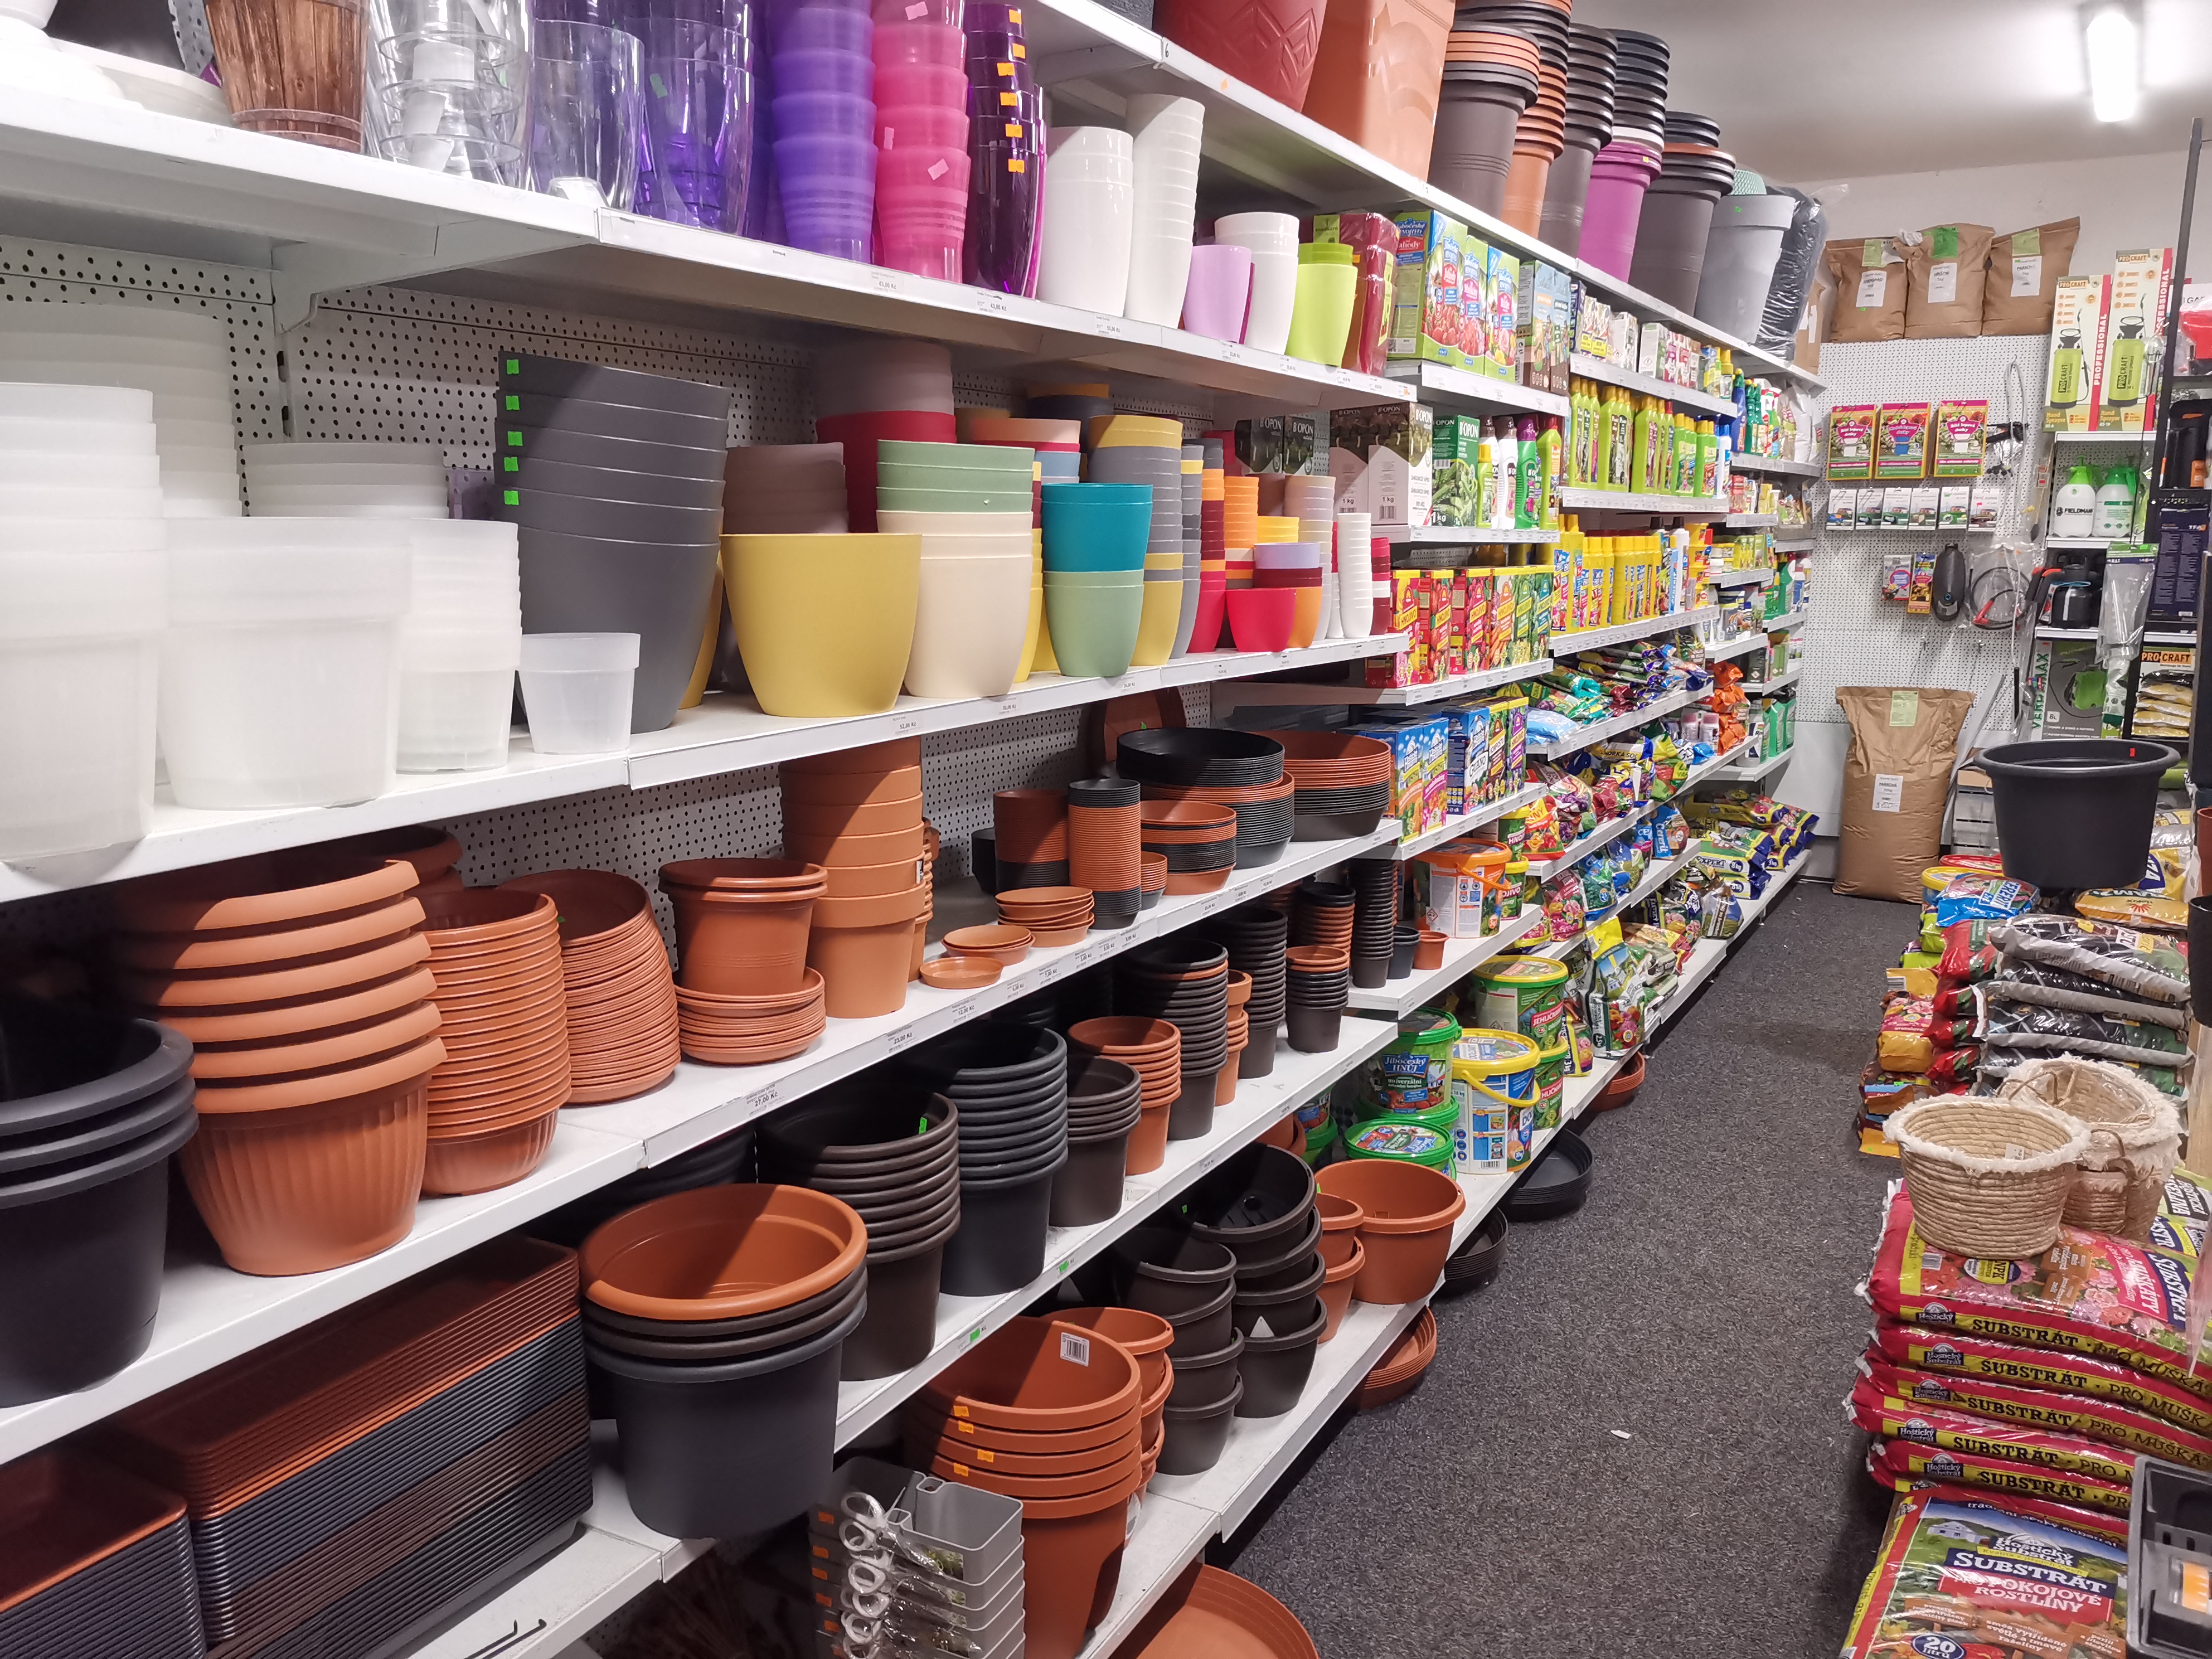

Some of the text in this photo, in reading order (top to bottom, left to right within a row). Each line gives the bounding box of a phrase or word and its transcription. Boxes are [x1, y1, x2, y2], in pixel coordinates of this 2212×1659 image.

[1398, 240, 1421, 249] ahody
[2093, 313, 2107, 387] PROFESSIONAL
[2141, 652, 2191, 662] PRO CRAFT
[755, 1091, 778, 1107] 27,00 Kč
[1992, 1260, 2006, 1280] NPK
[1972, 1318, 2079, 1347] SUBSTRÁT
[1981, 1360, 2087, 1389] SUBSTRÁT
[2109, 1383, 2143, 1401] PRO
[1967, 1397, 2072, 1427] SUBSTRÁT
[2089, 1419, 2127, 1438] PRO
[1953, 1436, 2116, 1477] SUBSTRÁT PRO
[1979, 1471, 2130, 1508] SUBSTRÁT PR
[1953, 1552, 2107, 1593] SUBSTRÁT
[1986, 1577, 2102, 1607] POKOJOVÉ
[1924, 1636, 1956, 1653] 20
